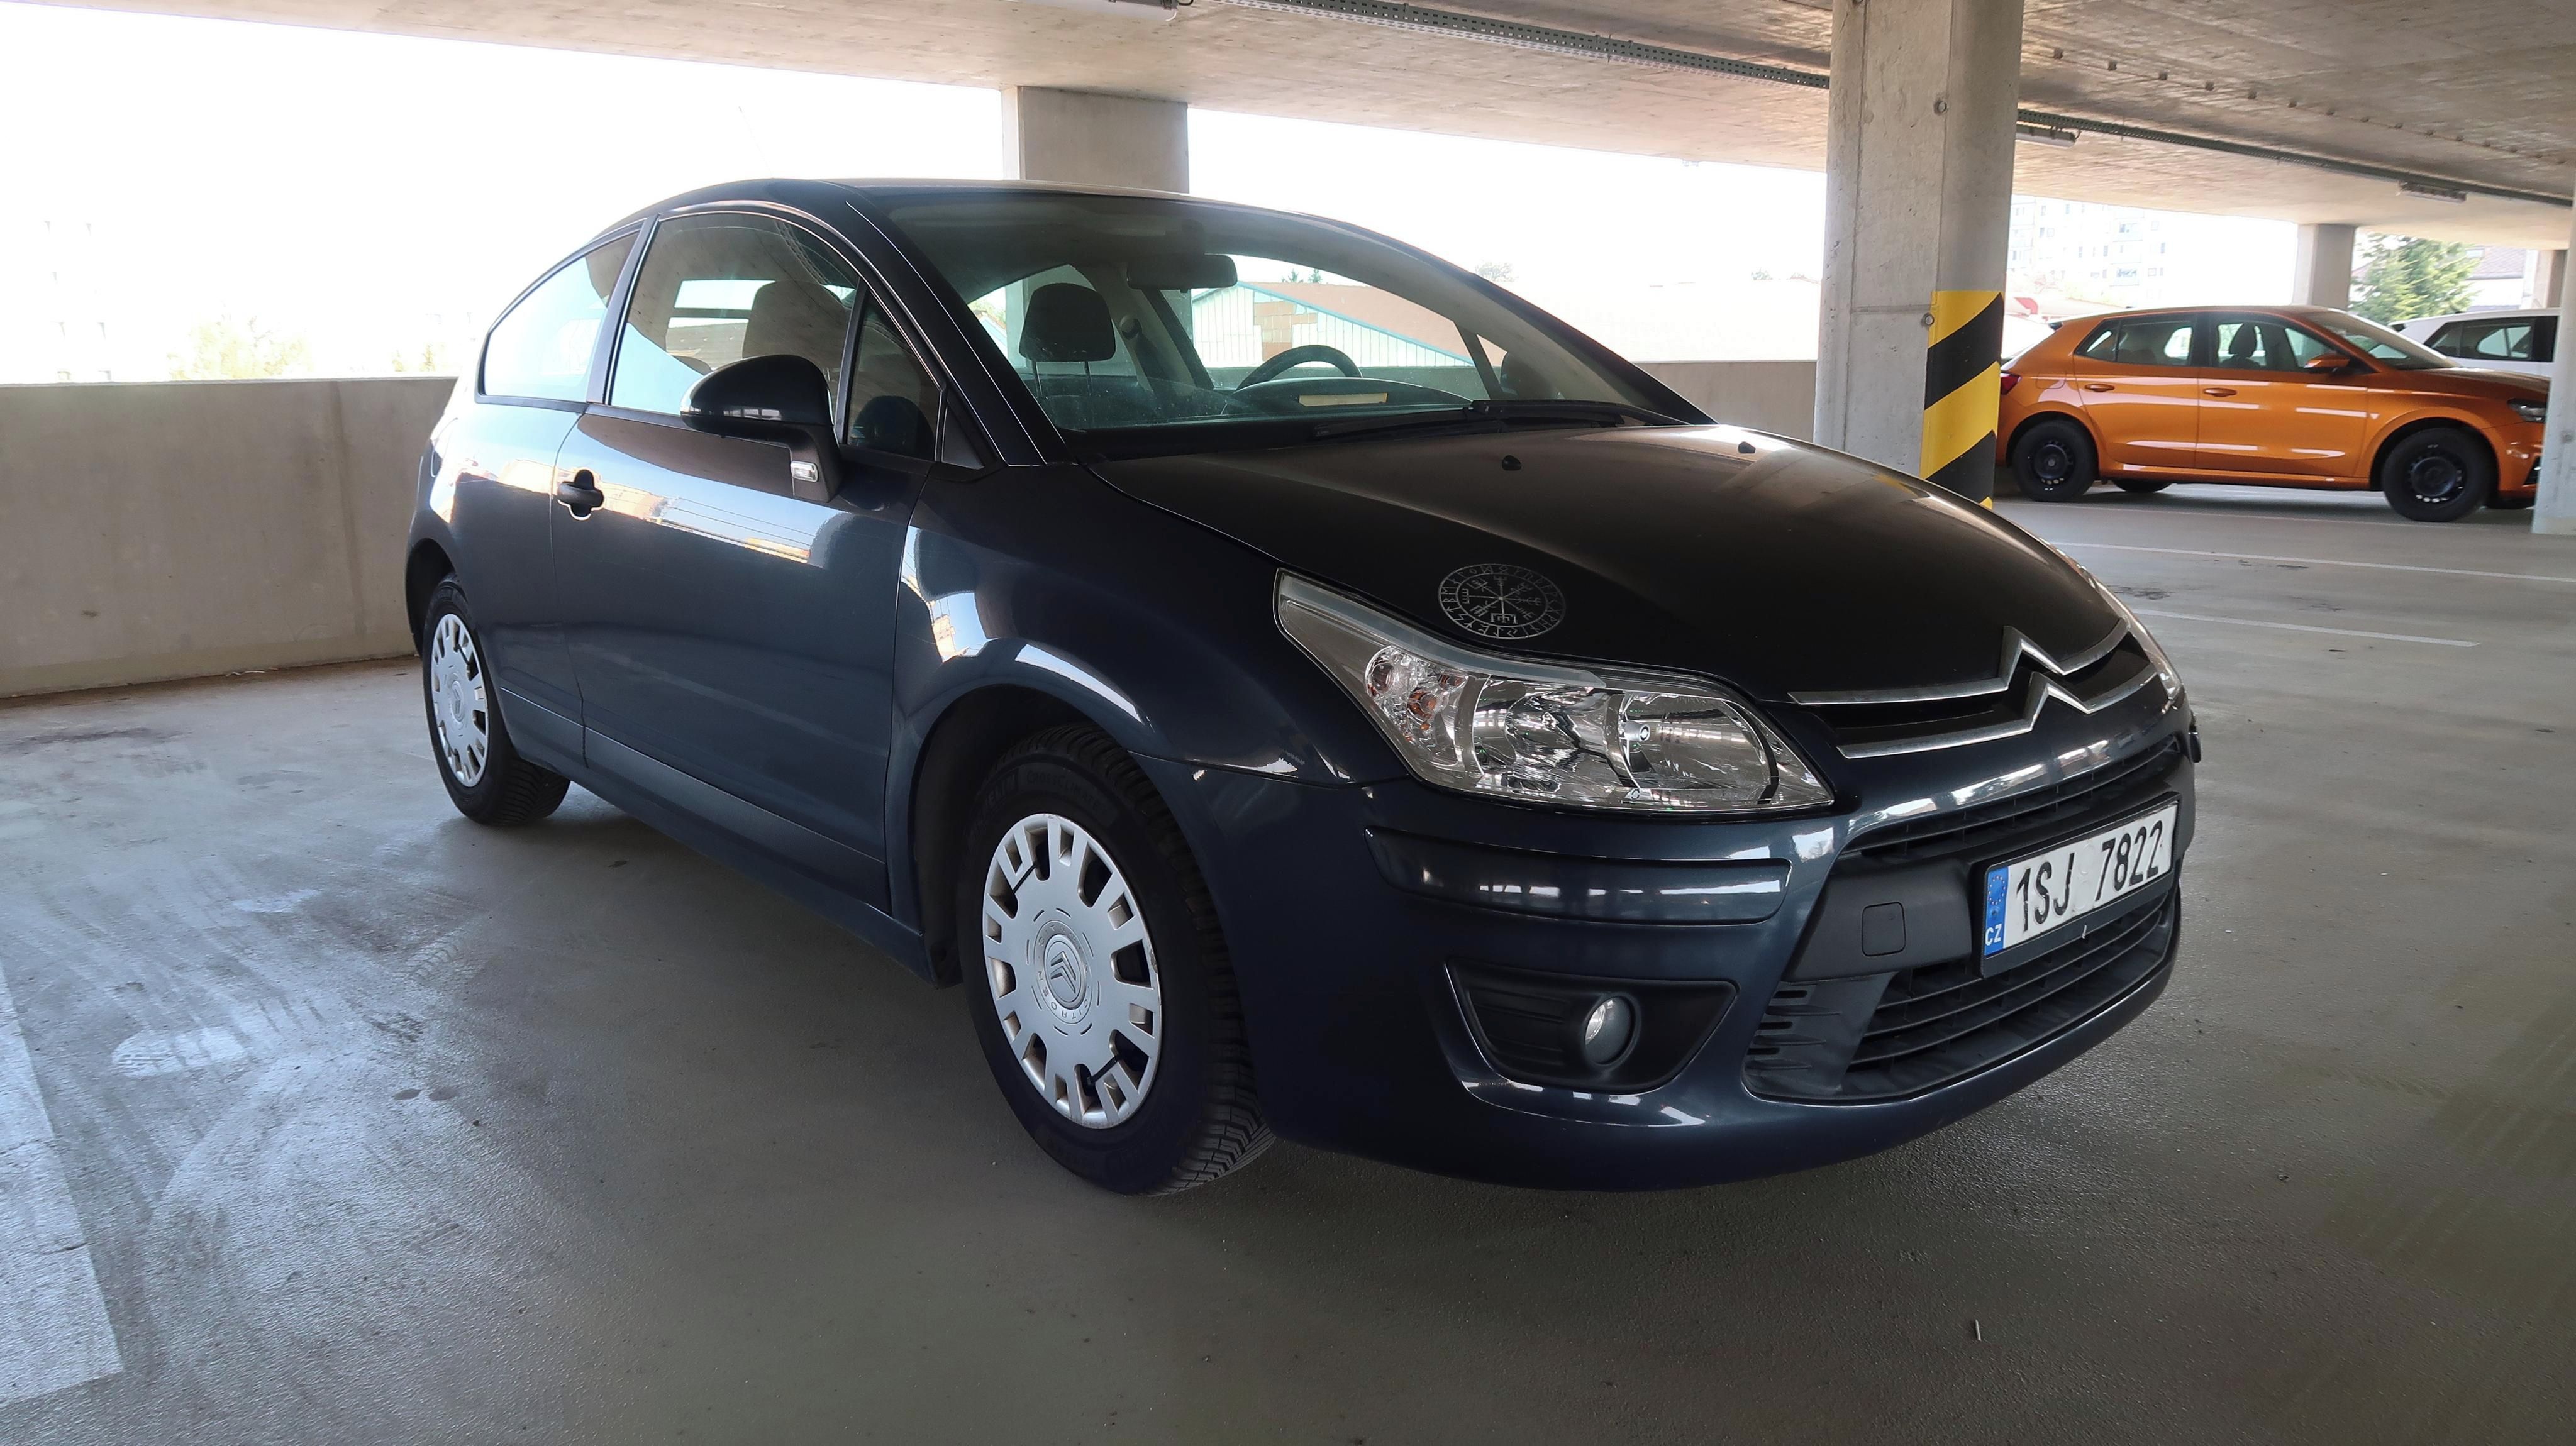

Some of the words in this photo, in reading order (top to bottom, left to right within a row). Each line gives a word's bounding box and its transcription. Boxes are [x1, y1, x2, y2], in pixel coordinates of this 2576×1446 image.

[2016, 853, 2075, 932] 1SJ
[2094, 820, 2163, 901] 7822
[1985, 923, 2002, 946] CZ
